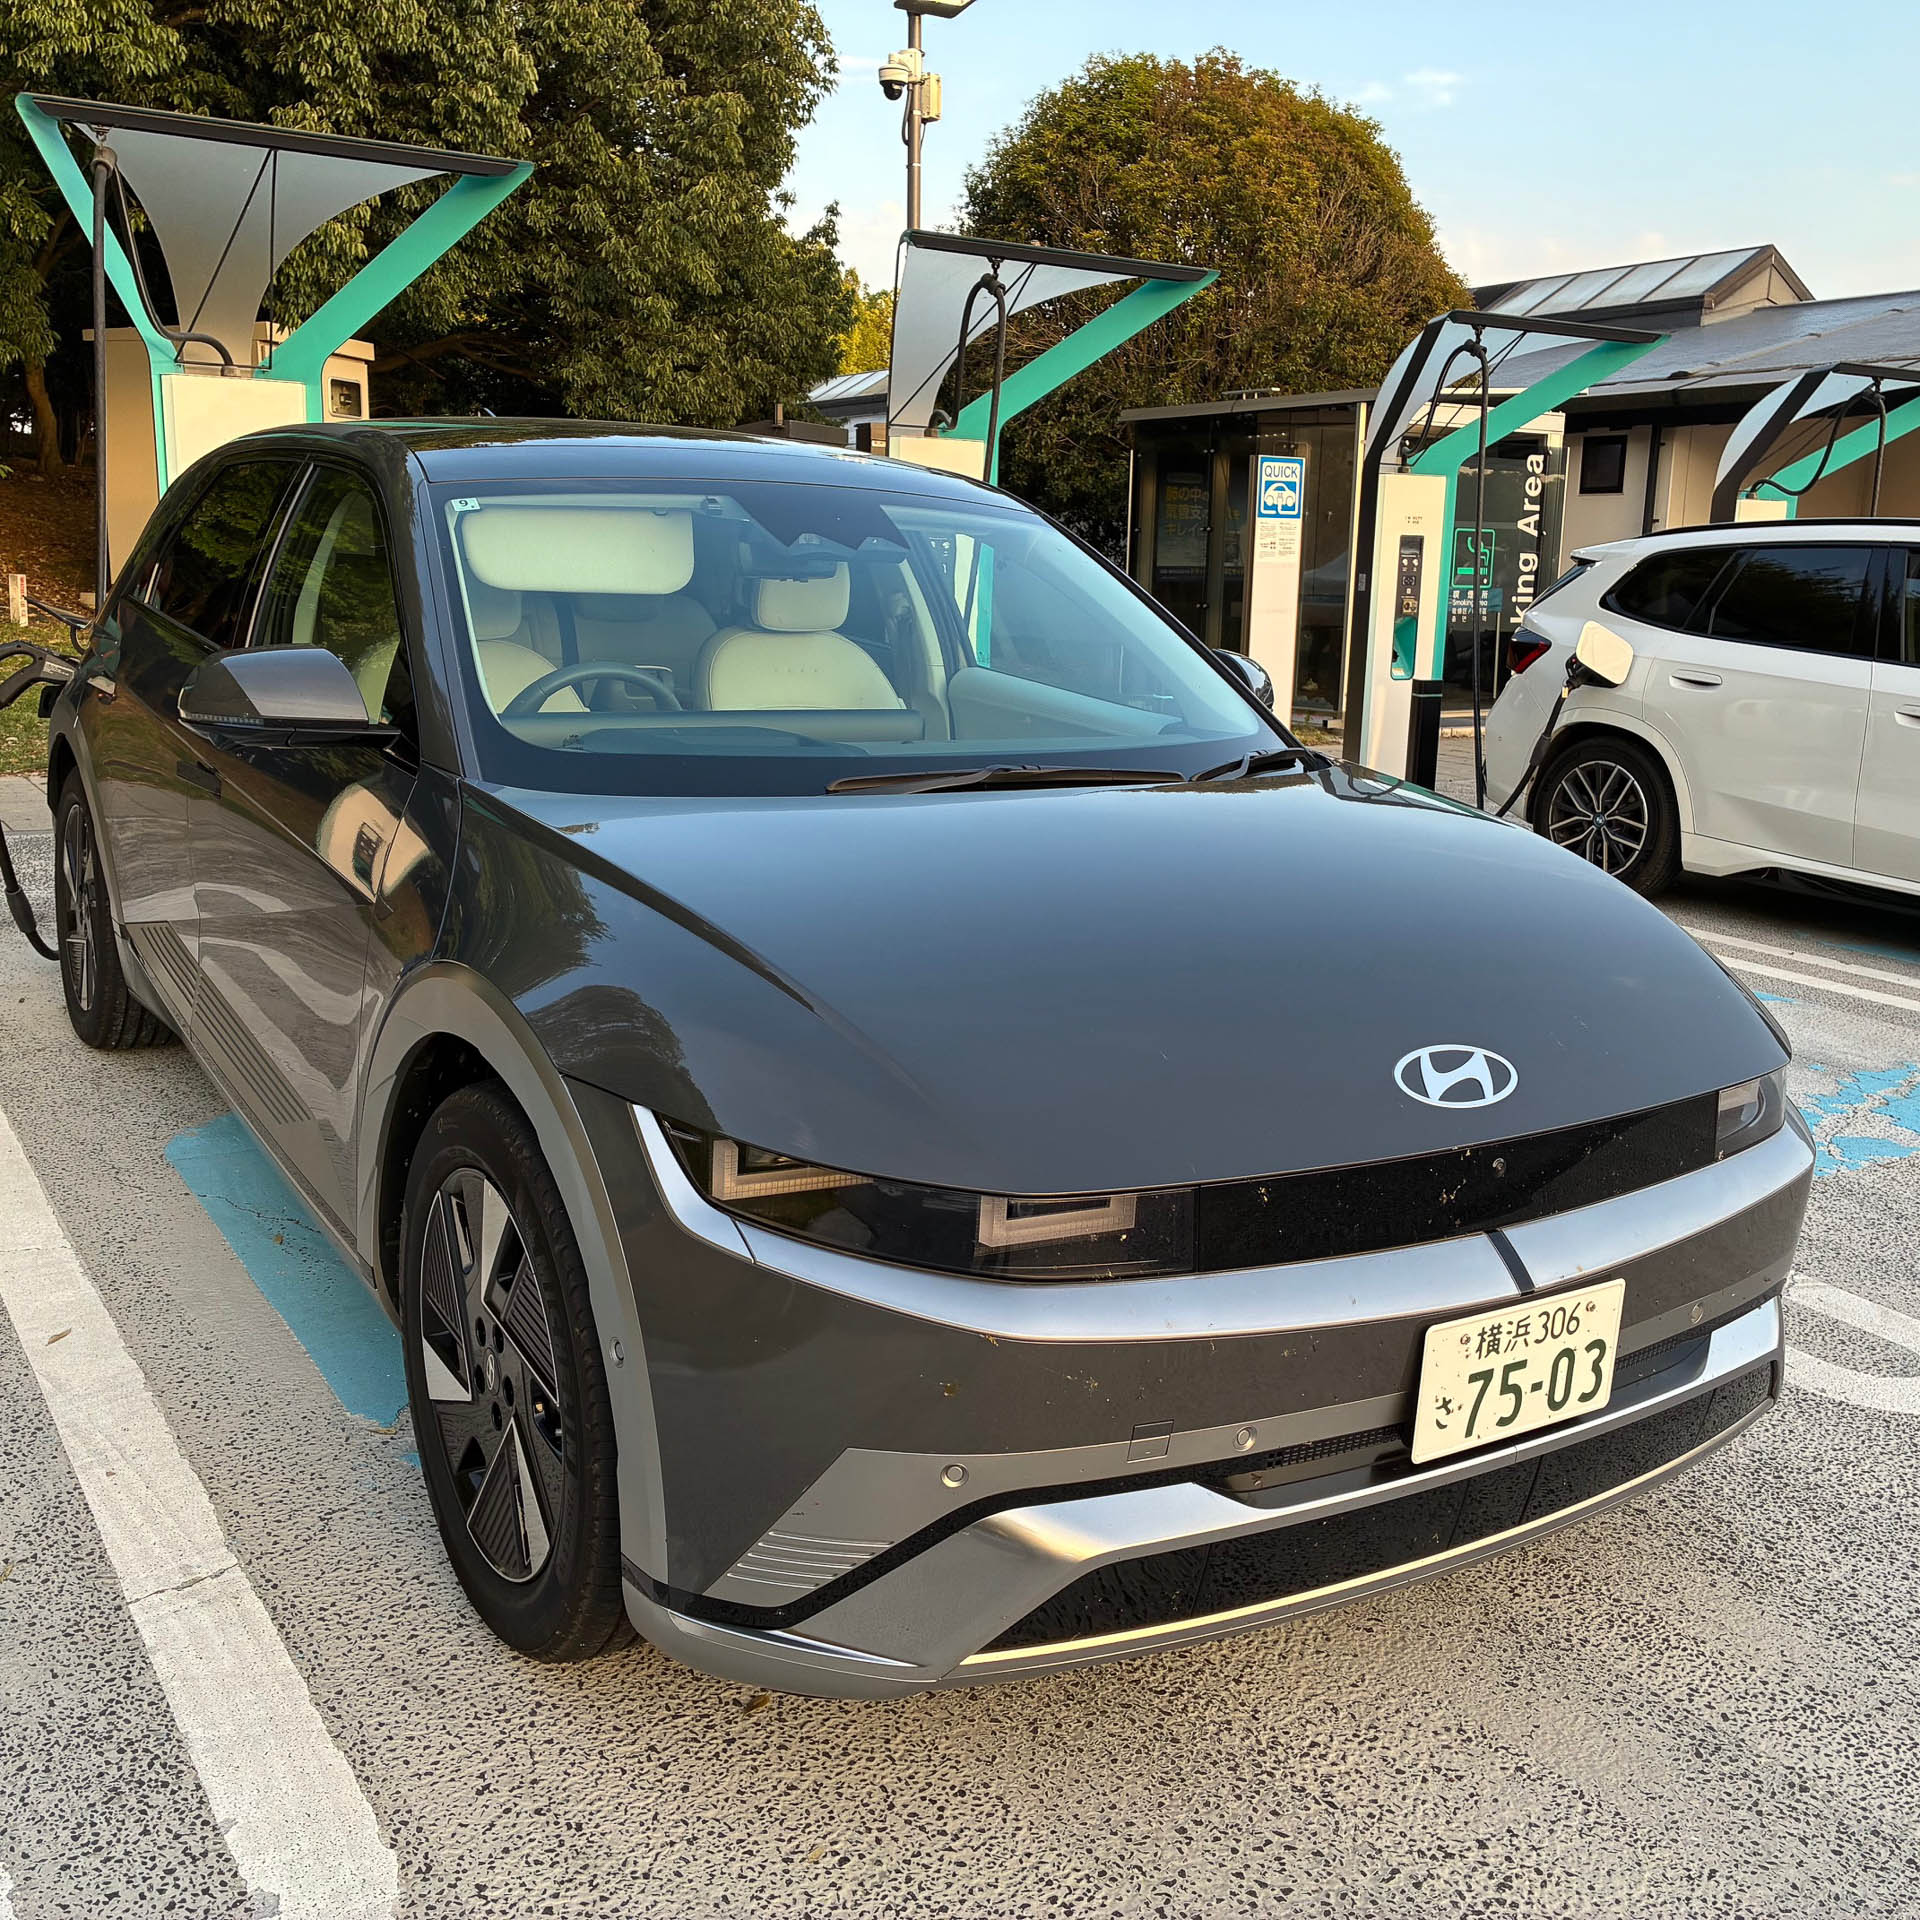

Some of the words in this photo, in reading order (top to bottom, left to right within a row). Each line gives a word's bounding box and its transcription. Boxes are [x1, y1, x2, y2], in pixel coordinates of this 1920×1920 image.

[1264, 465, 1298, 478] QUICK
[1517, 454, 1545, 537] Area
[1510, 553, 1539, 623] king
[1475, 1315, 1531, 1360] 横浜
[1534, 1302, 1581, 1344] 306
[1435, 1396, 1453, 1430] さ
[1464, 1338, 1607, 1439] 75-03
